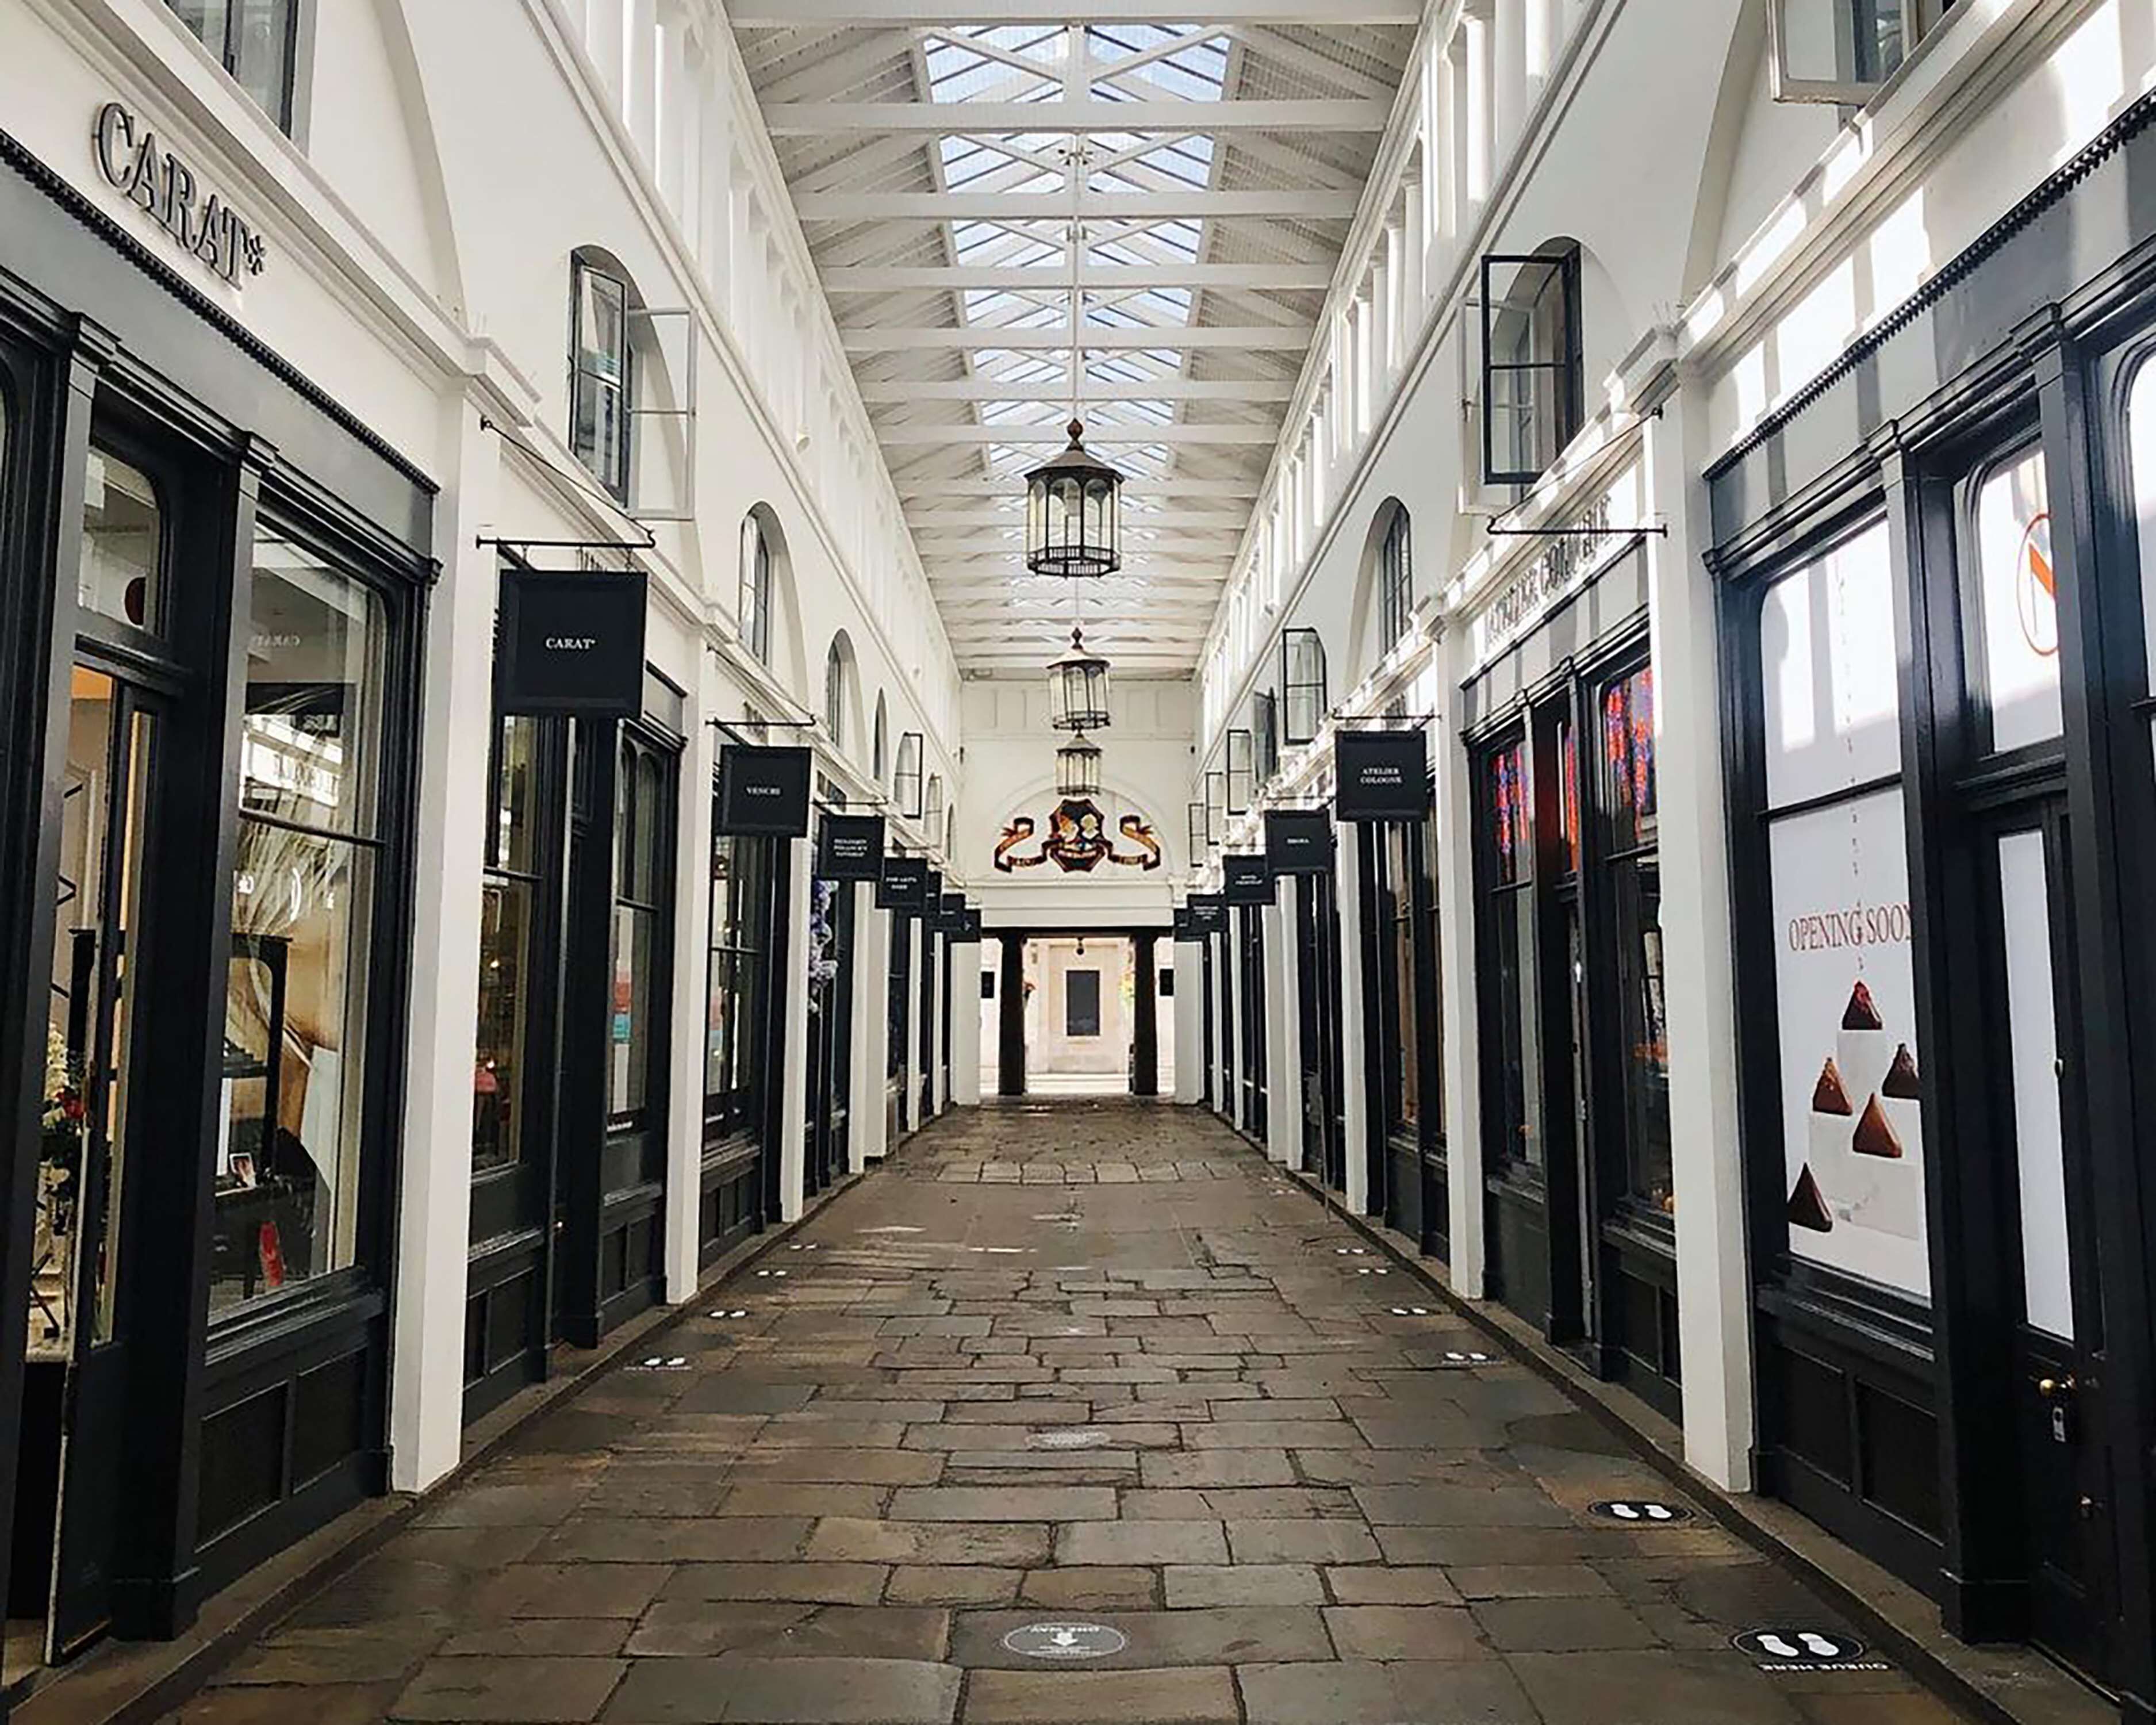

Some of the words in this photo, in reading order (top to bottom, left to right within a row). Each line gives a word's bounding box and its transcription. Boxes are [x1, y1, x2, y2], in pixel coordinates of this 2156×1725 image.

[97, 102, 252, 291] CARAT
[546, 637, 593, 649] CARAT
[1363, 767, 1399, 775] ATELIER
[1360, 776, 1402, 784] COLOGNE
[1789, 910, 1862, 951] OPENING
